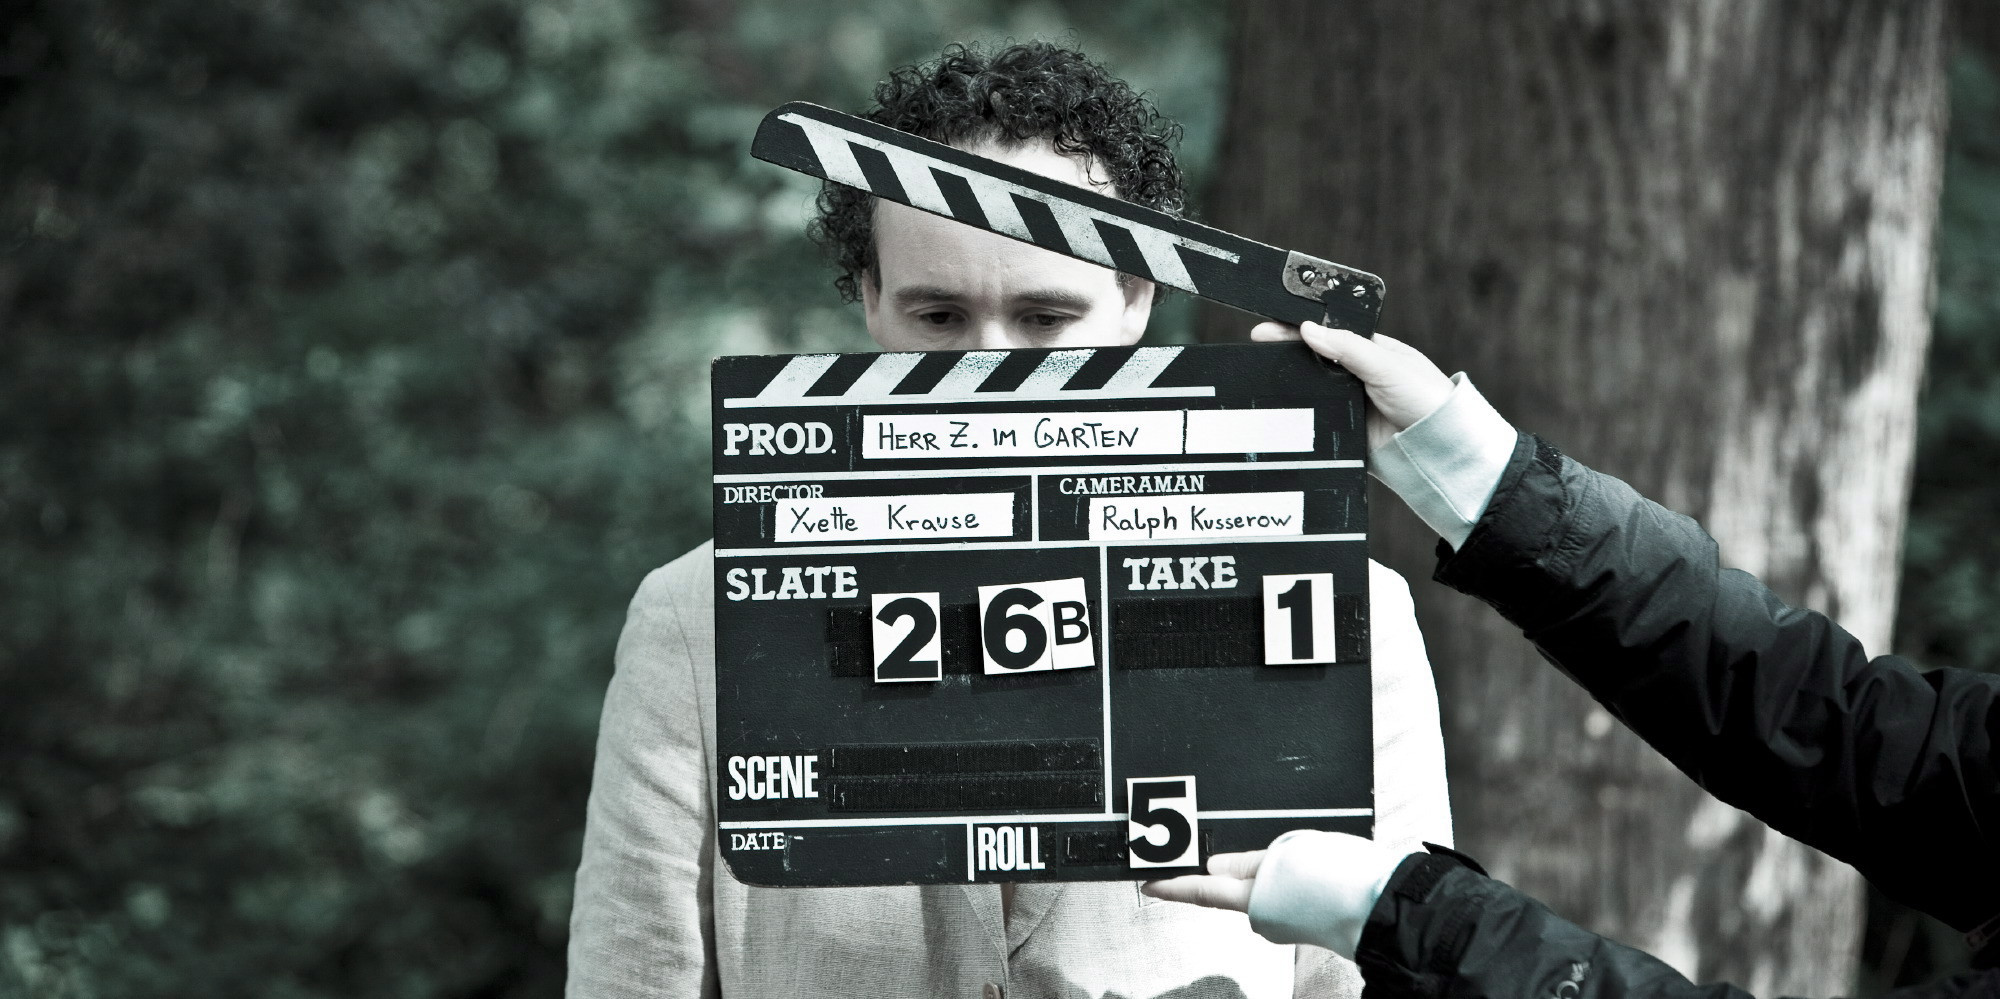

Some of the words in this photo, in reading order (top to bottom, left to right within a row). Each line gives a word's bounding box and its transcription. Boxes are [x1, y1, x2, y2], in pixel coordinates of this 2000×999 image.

[723, 422, 837, 456] PROD.
[879, 422, 941, 451] HERR
[950, 421, 979, 449] Z.
[1034, 417, 1139, 449] GARTEN
[723, 485, 824, 504] DIRECTOR
[1059, 475, 1205, 495] CAMERAMAN
[790, 506, 858, 534] Yvette
[887, 504, 980, 531] Krause
[1103, 505, 1178, 538] Ralph
[1191, 505, 1291, 531] Kusserow
[726, 566, 859, 601] SLATE
[1122, 555, 1239, 591] TAKE
[1277, 579, 1314, 660] 1
[876, 597, 939, 679] 2
[728, 755, 819, 801] SCENE
[1129, 780, 1192, 863] 5
[731, 832, 785, 851] DATE
[977, 826, 1046, 871] ROLL
